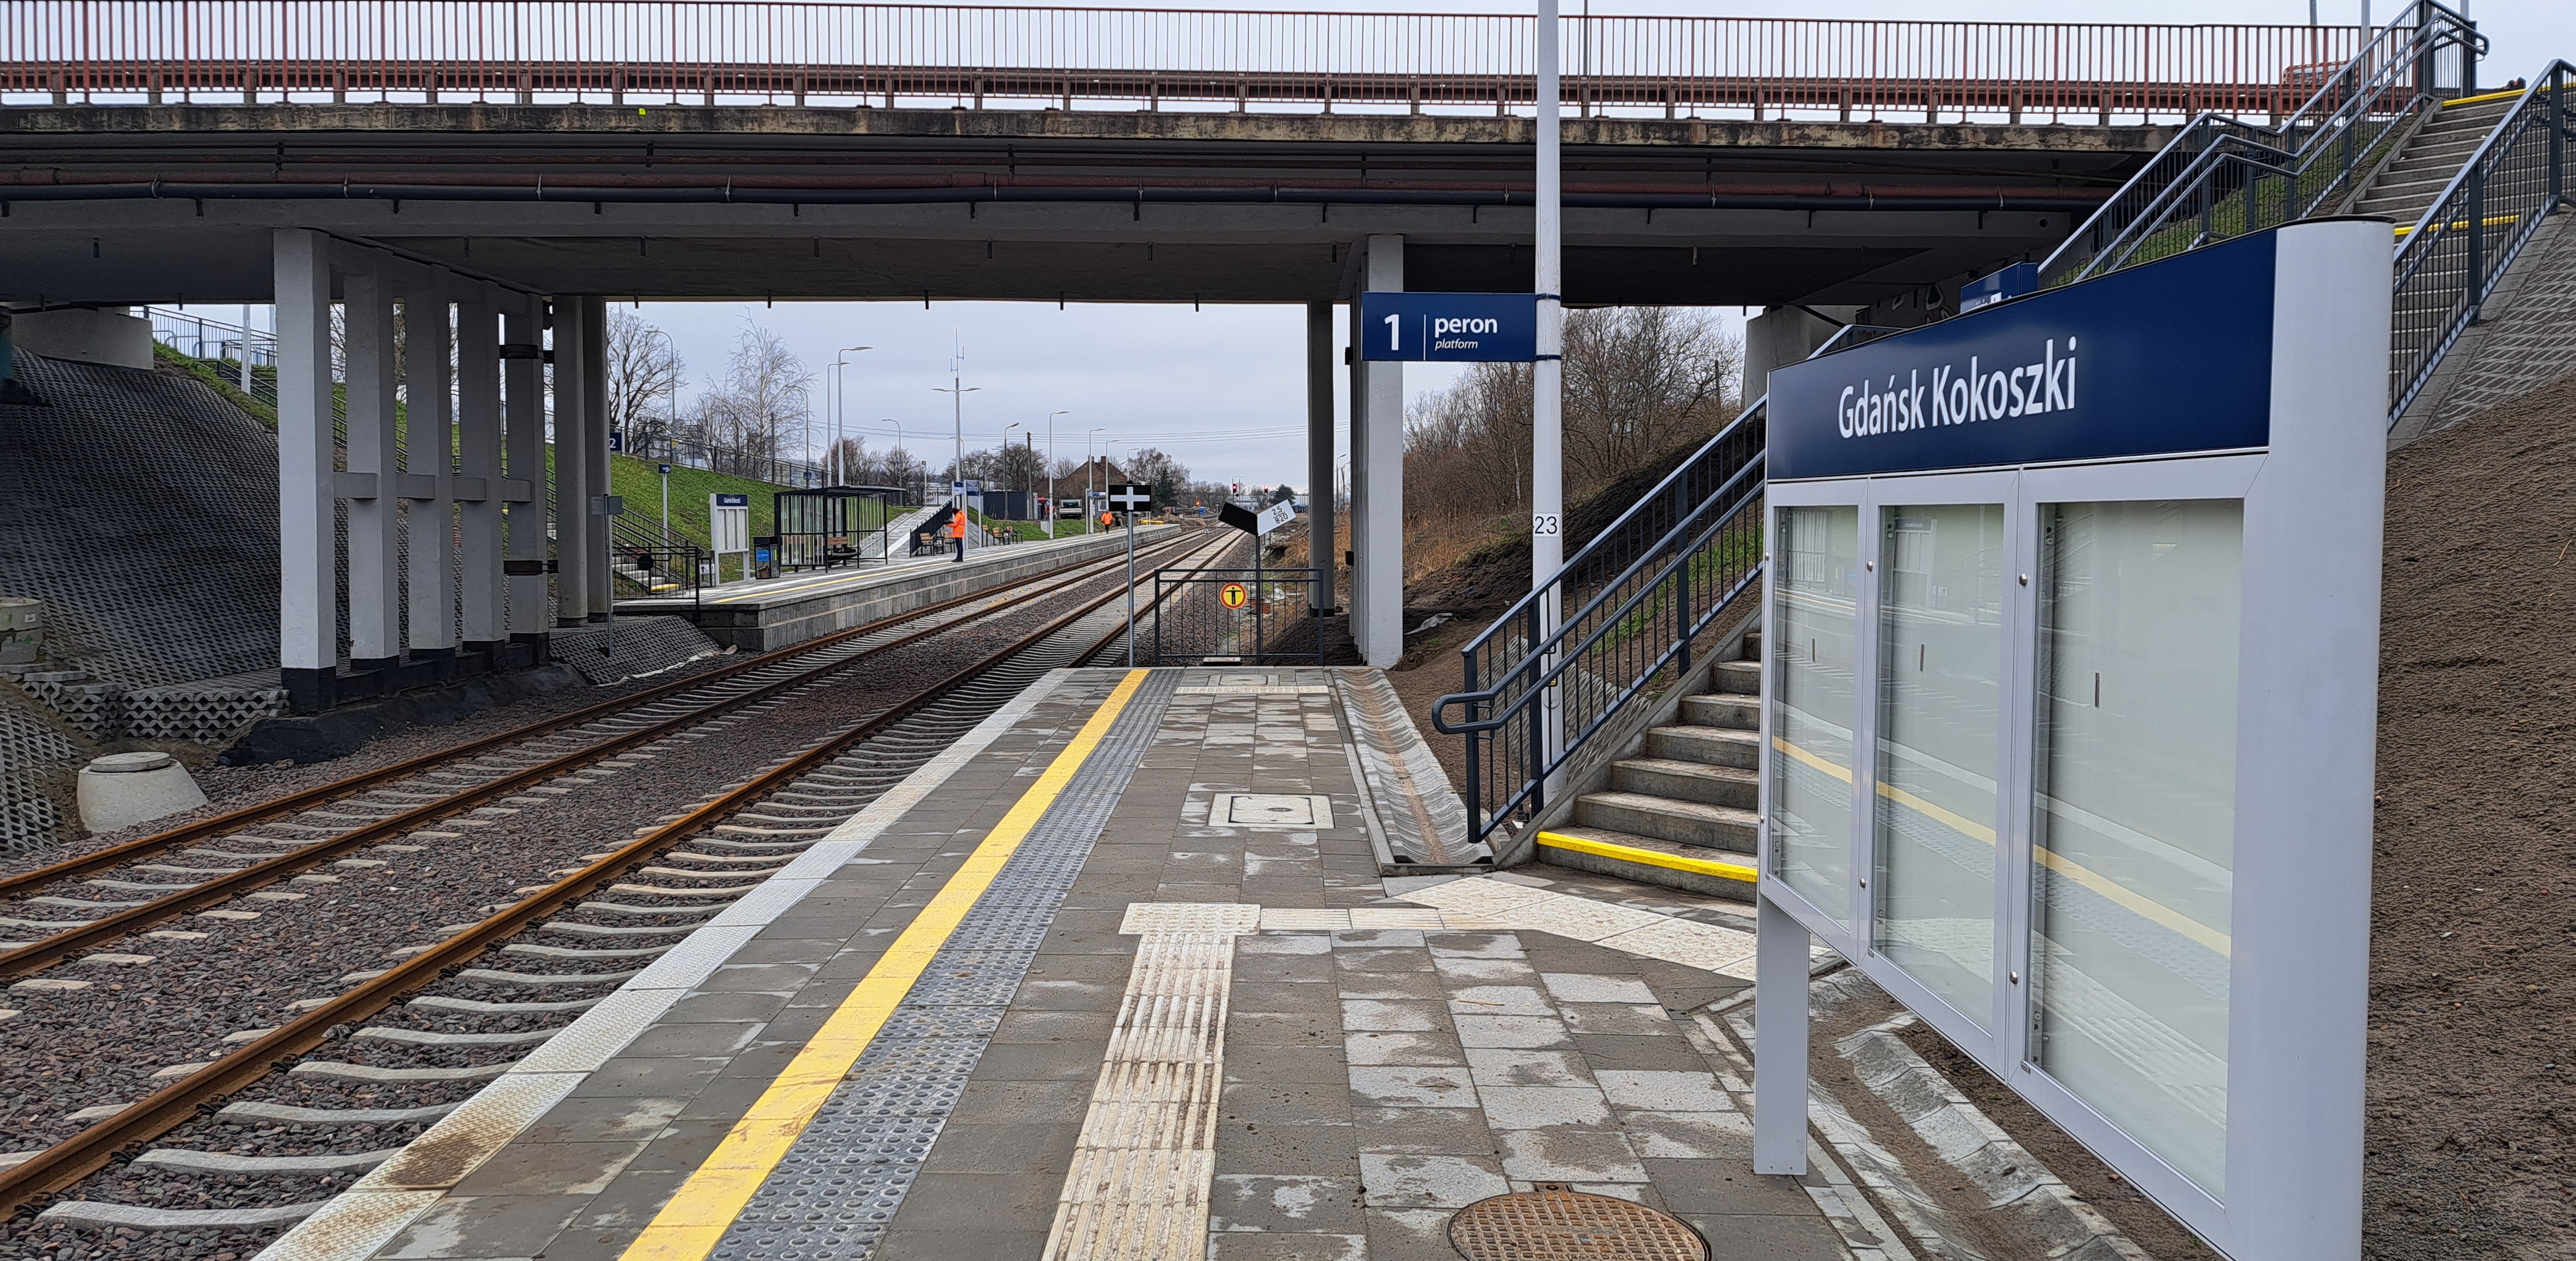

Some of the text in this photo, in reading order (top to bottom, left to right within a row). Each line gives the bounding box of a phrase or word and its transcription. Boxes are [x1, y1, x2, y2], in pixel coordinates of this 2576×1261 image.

[1384, 314, 1399, 351] 1
[1435, 318, 1498, 338] peron
[1435, 338, 1479, 351] platform
[1838, 336, 2077, 439] Gdańsk Kokoszki
[609, 438, 617, 448] 2
[1271, 505, 1282, 516] 2,5
[1275, 513, 1289, 524] 820
[1535, 516, 1558, 534] 23
